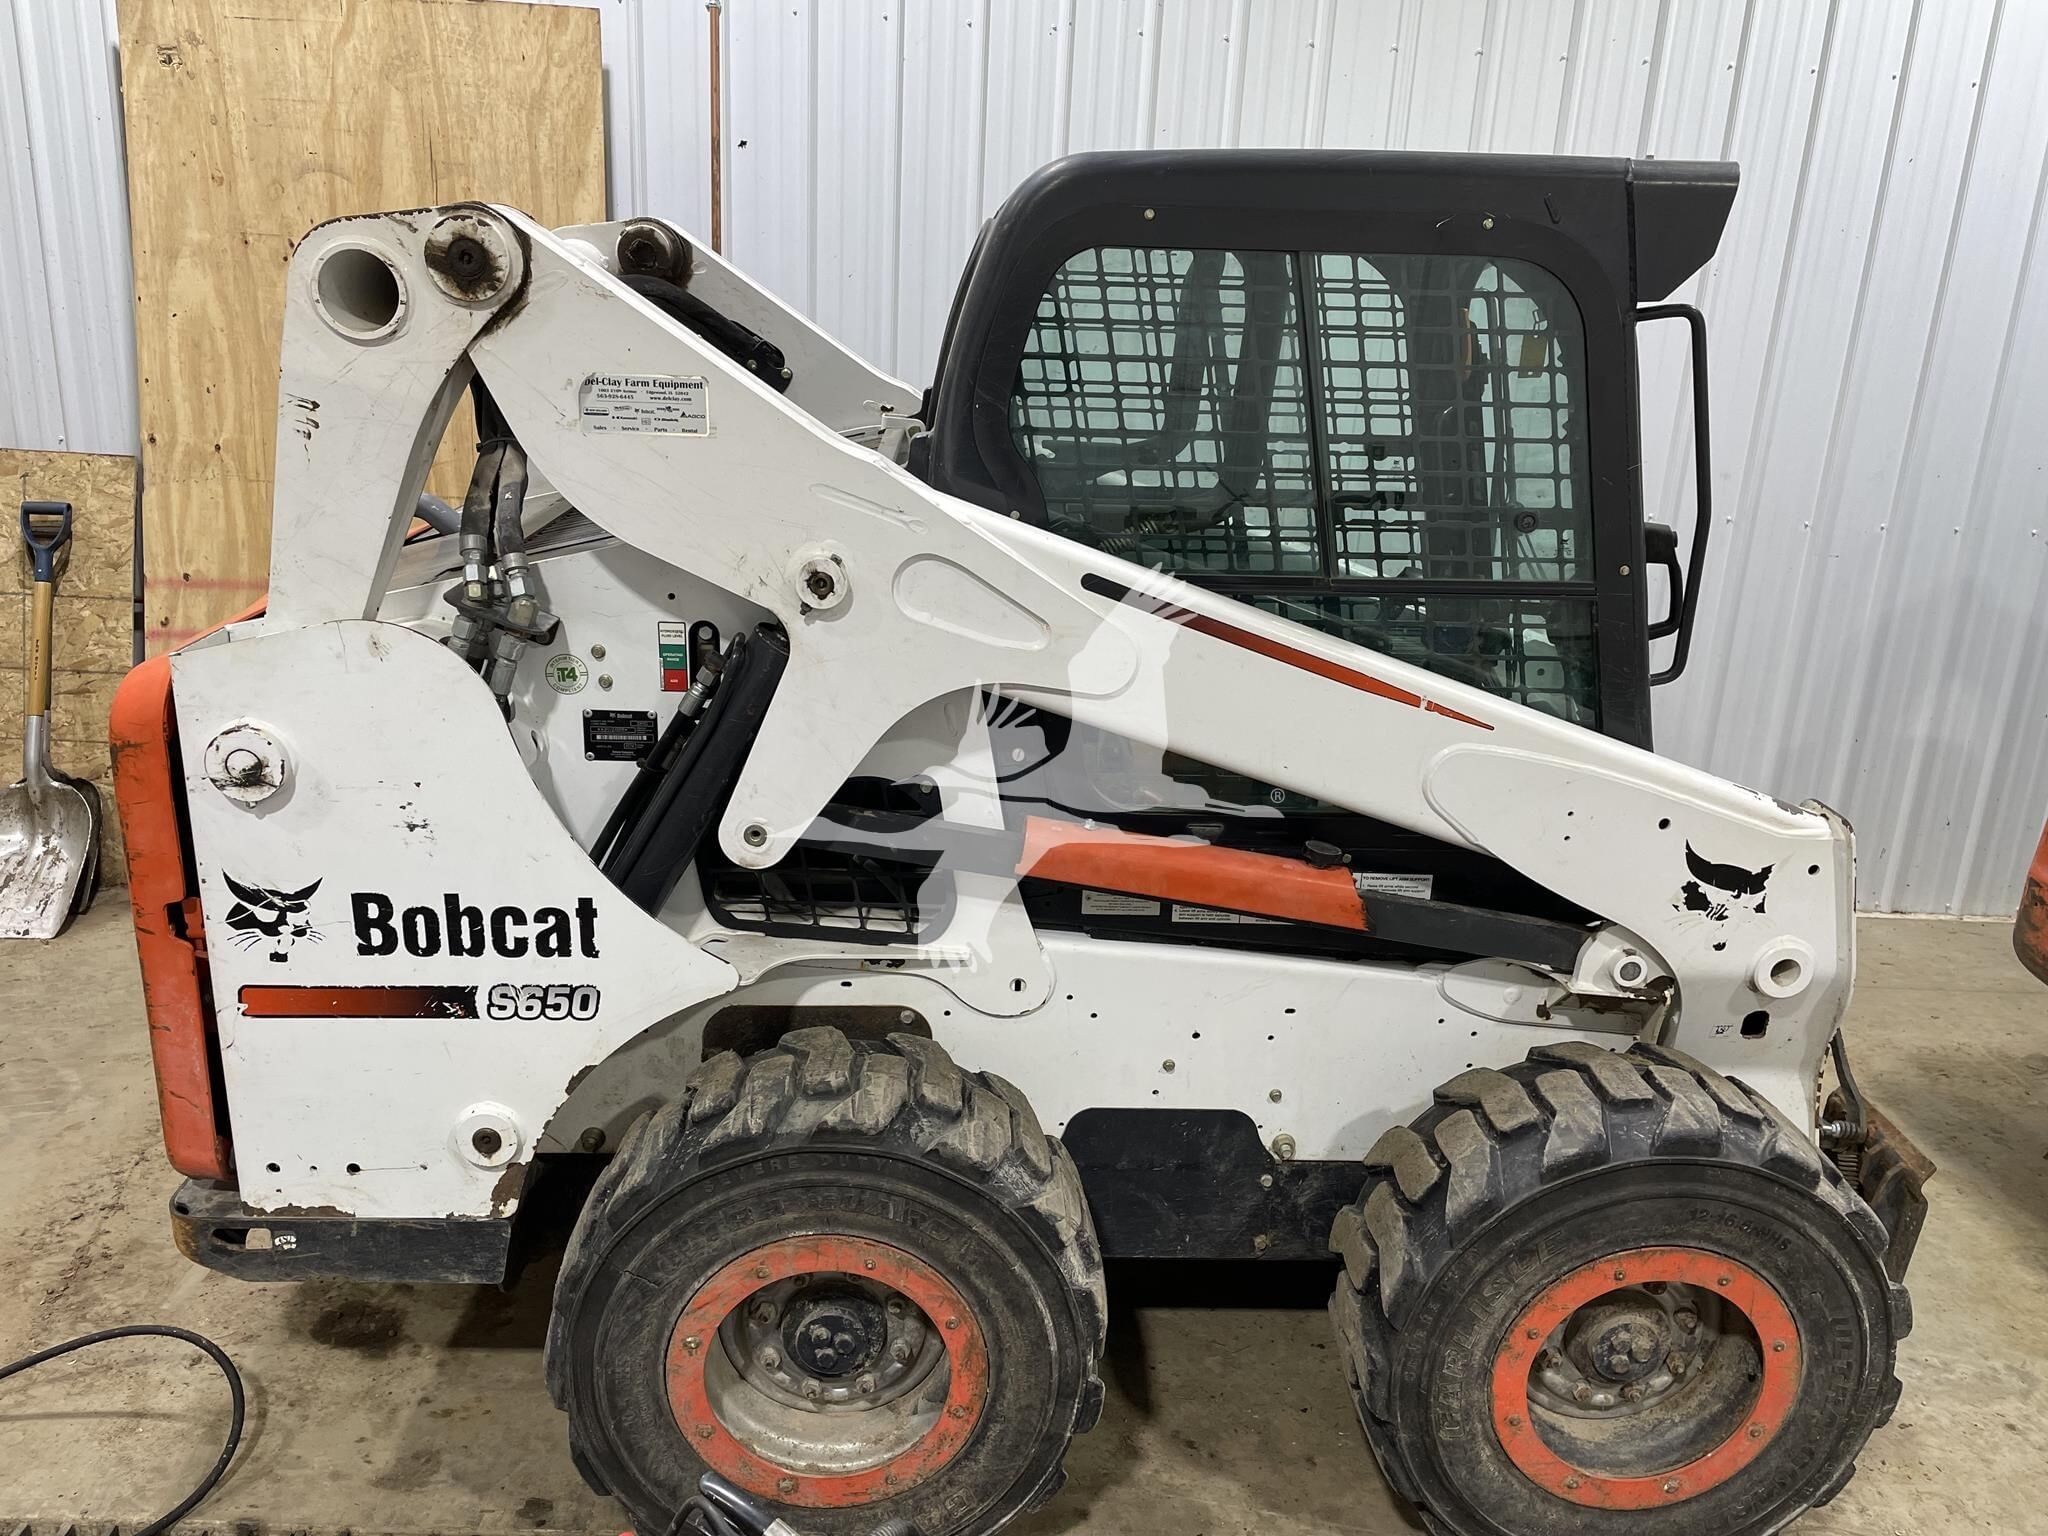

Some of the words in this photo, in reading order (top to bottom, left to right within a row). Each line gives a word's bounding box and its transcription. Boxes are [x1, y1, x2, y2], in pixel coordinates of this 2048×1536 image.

[584, 377, 622, 388] Del-Clay
[625, 378, 650, 388] Farm
[653, 380, 704, 390] Equipment
[351, 893, 599, 959] Bobcat
[487, 983, 600, 1021] S650
[1438, 1229, 1567, 1441] CARLISLE
